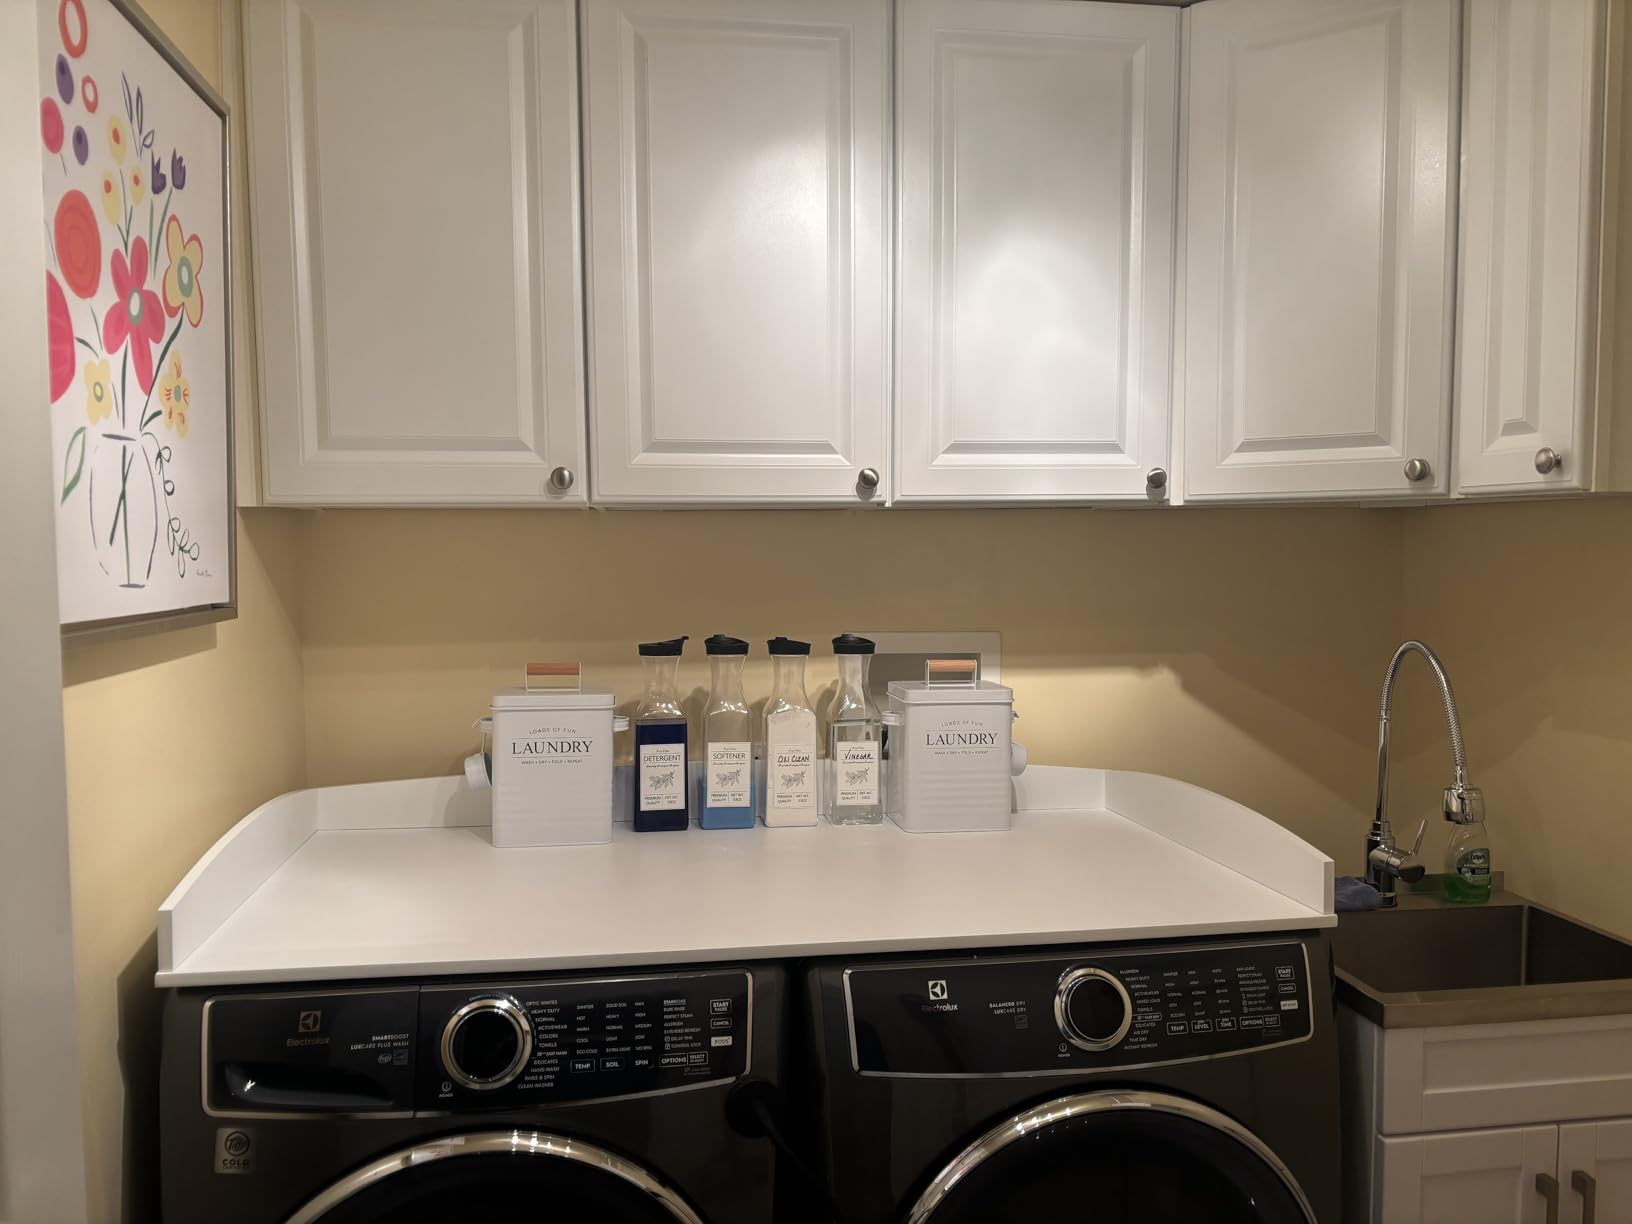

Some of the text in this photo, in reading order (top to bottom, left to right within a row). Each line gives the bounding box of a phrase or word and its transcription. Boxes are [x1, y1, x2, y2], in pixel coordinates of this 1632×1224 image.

[941, 720, 960, 728] LOADS
[529, 727, 551, 735] LOADS
[563, 727, 577, 735] FUN
[926, 732, 998, 747] LAUNDRY
[511, 740, 593, 755] LAUNDRY
[643, 754, 681, 763] DETERGENT
[712, 752, 746, 760] SOFTENER
[777, 754, 810, 763] OXI CLEAN
[989, 1001, 1015, 1009] BALANCED
[372, 1034, 409, 1042] SMARTBOOST
[634, 1059, 649, 1067] SPIN
[661, 1056, 687, 1064] OPTIONS
[605, 1061, 620, 1069] SOIL
[517, 1080, 554, 1090] CLEAN WASHER
